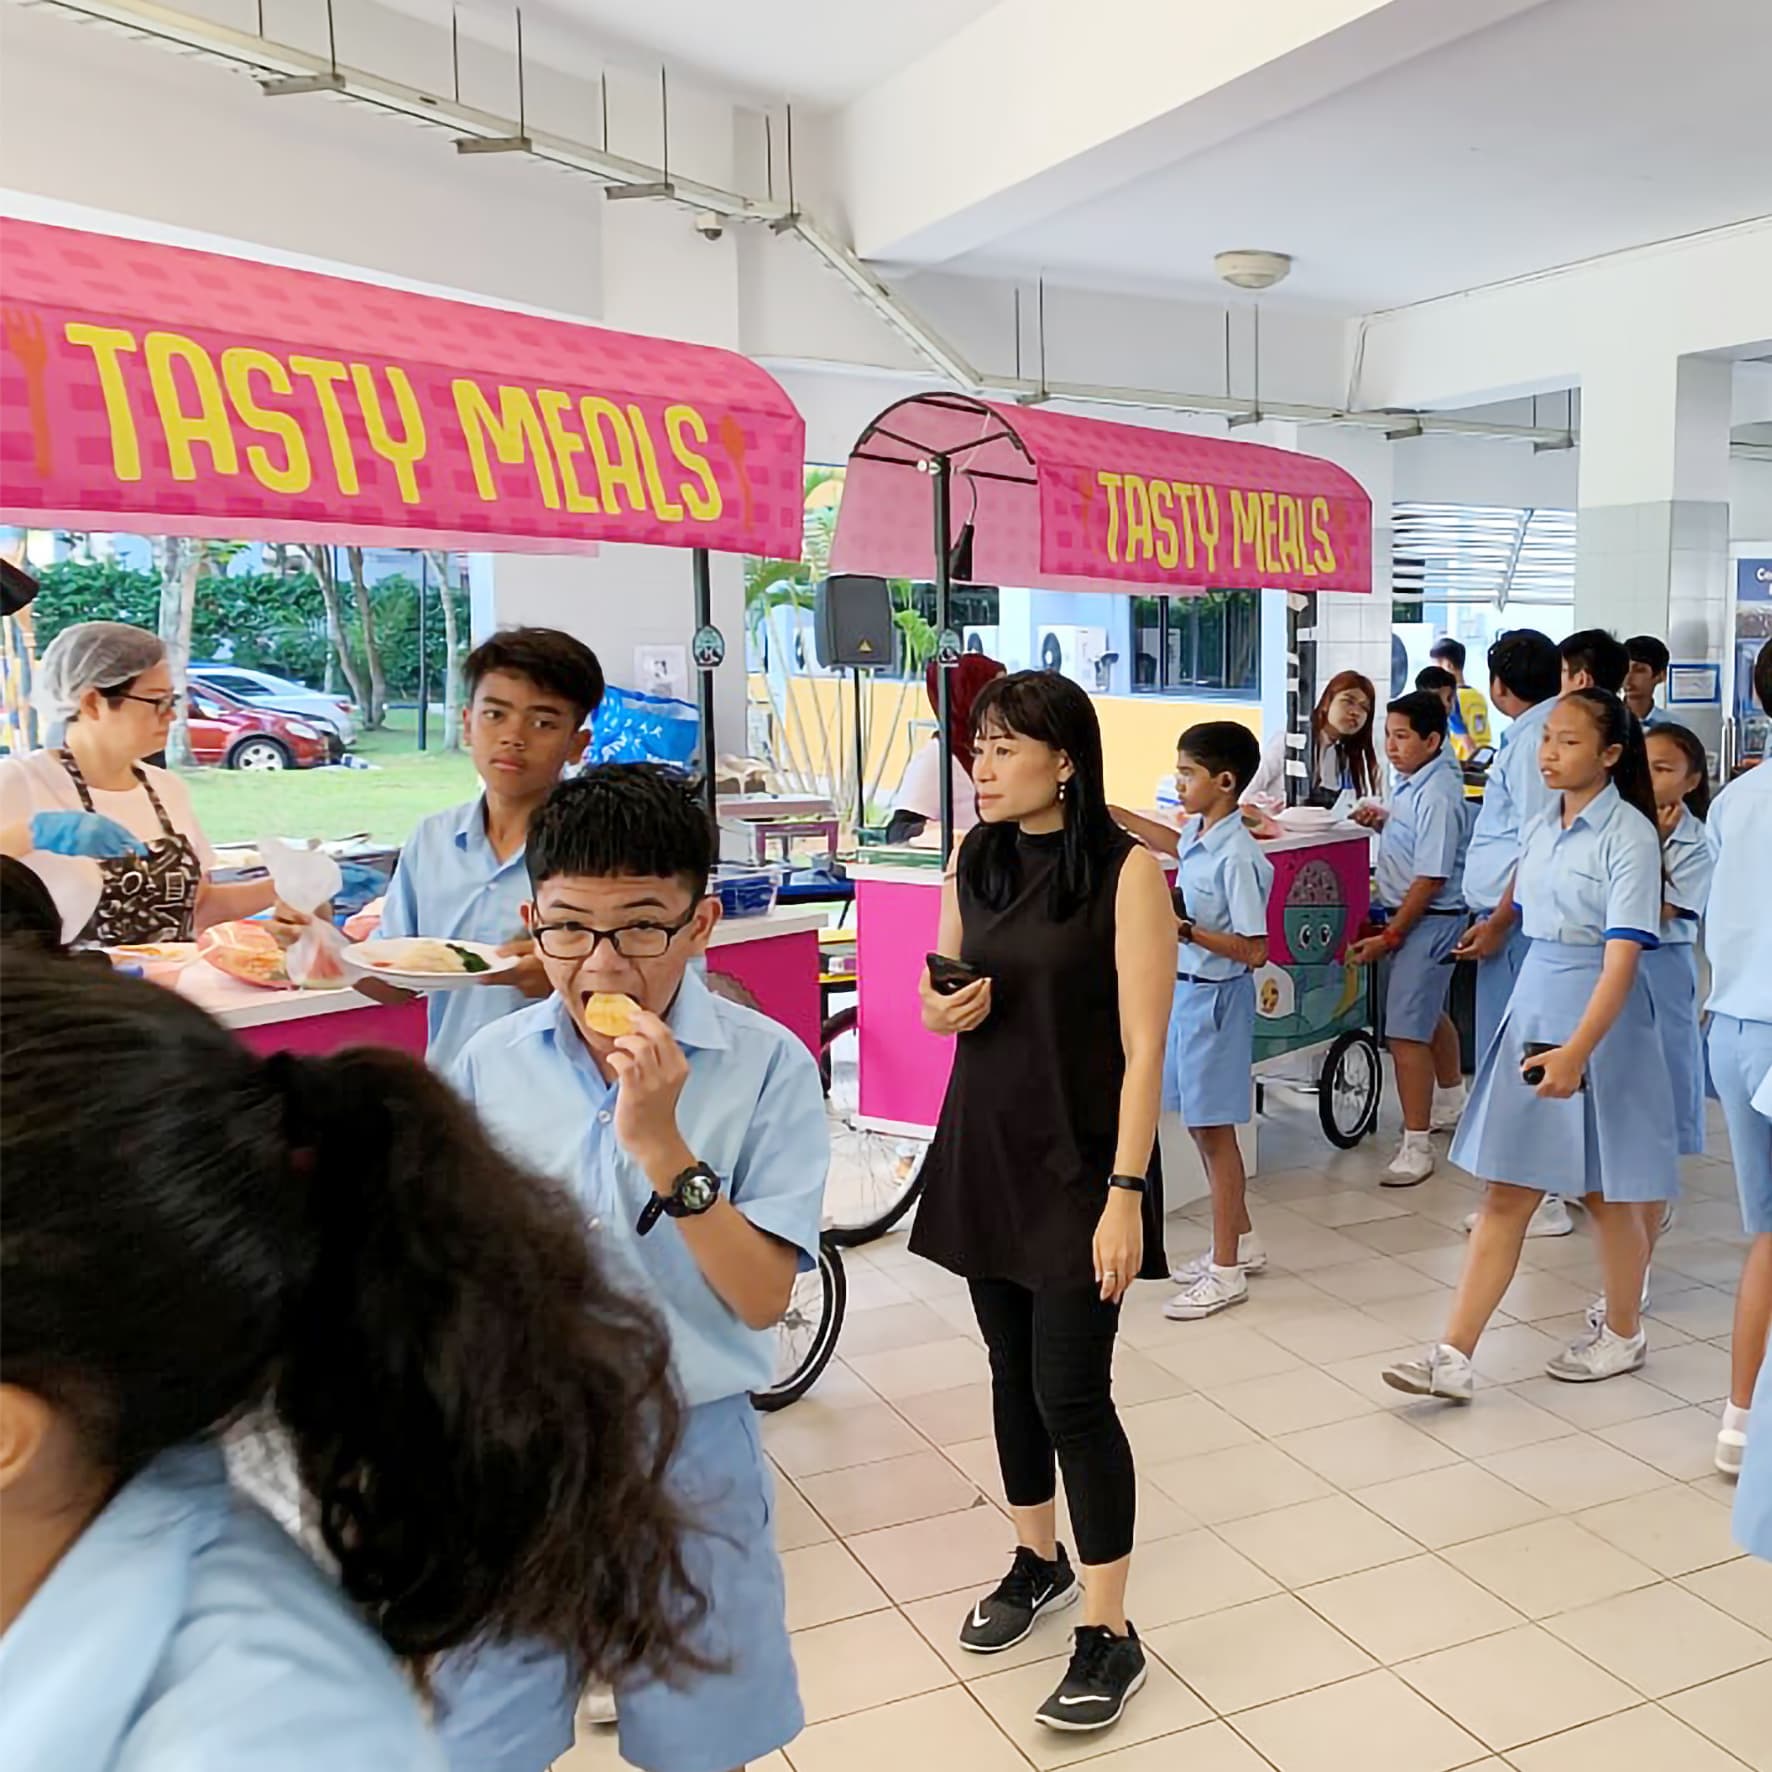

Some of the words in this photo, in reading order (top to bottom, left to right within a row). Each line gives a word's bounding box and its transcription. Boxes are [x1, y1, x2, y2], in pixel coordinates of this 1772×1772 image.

[66, 322, 426, 504] TASTY
[453, 380, 722, 521] MEALS
[1098, 471, 1218, 573] TASTY
[1230, 490, 1336, 576] MEALS
